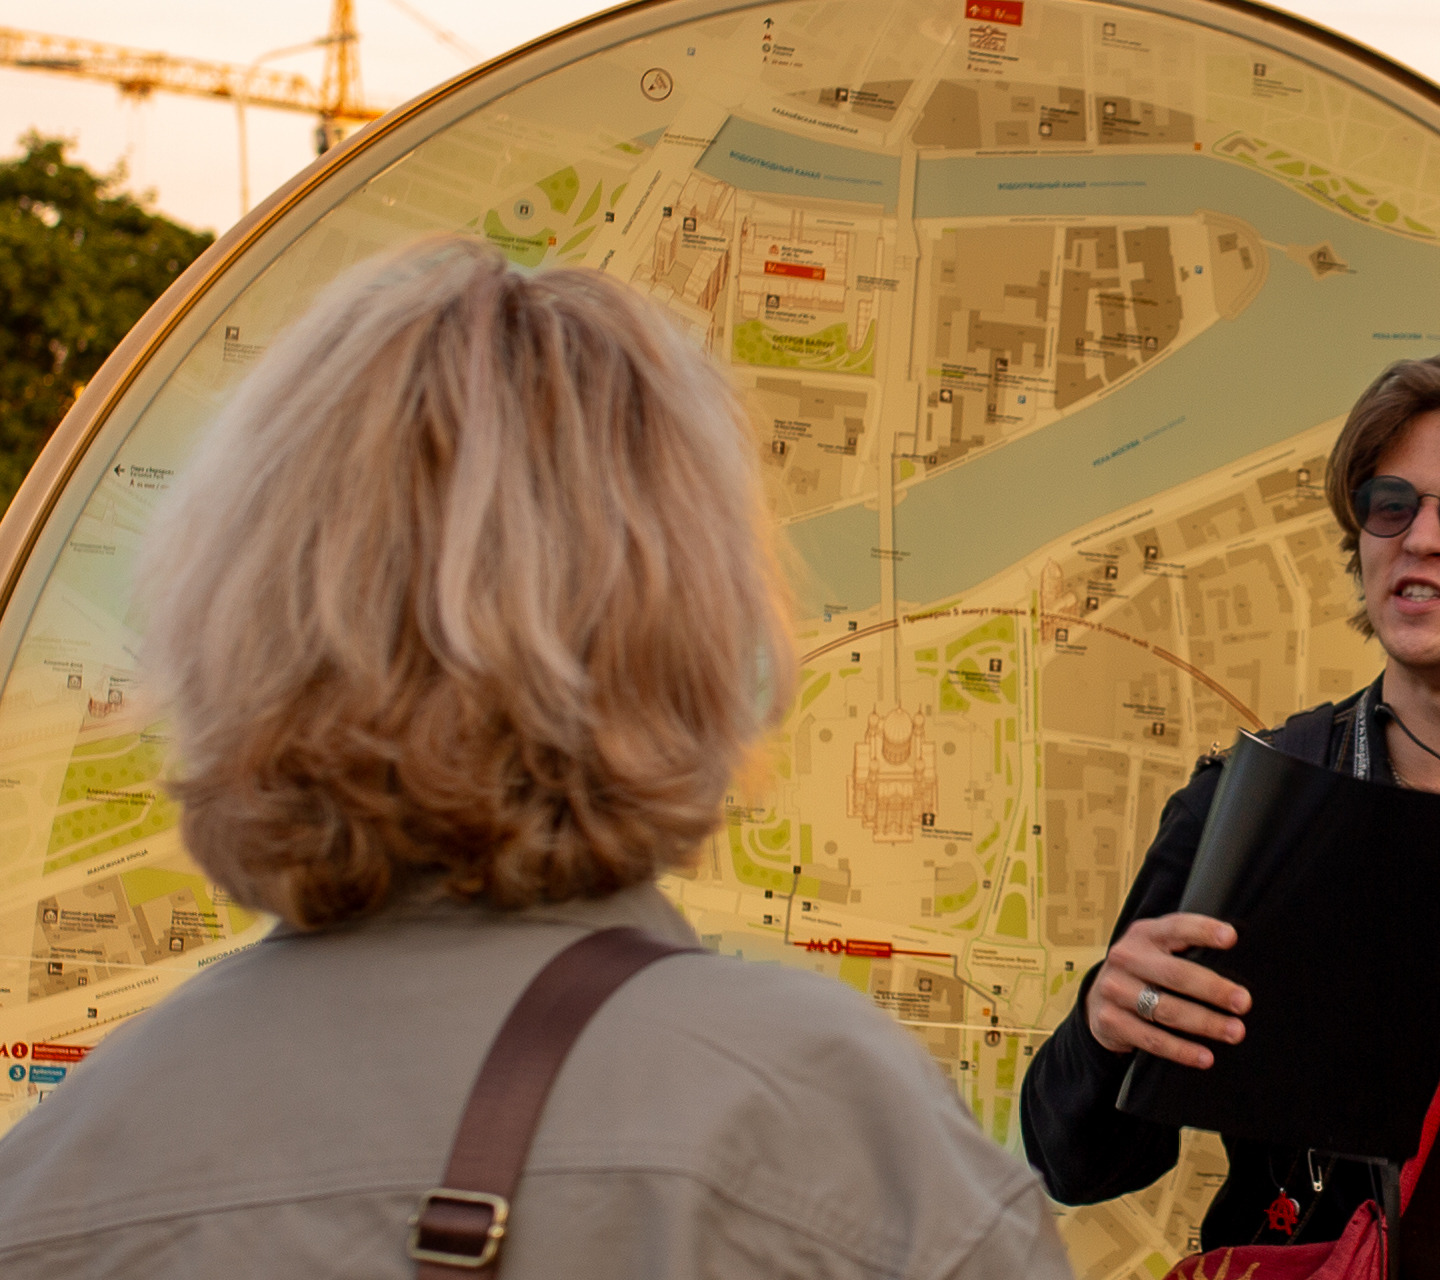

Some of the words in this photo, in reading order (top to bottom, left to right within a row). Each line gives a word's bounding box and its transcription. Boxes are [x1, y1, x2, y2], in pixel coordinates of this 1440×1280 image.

[903, 608, 951, 624] Примерно
[953, 606, 959, 617] 5
[961, 606, 989, 618] минут
